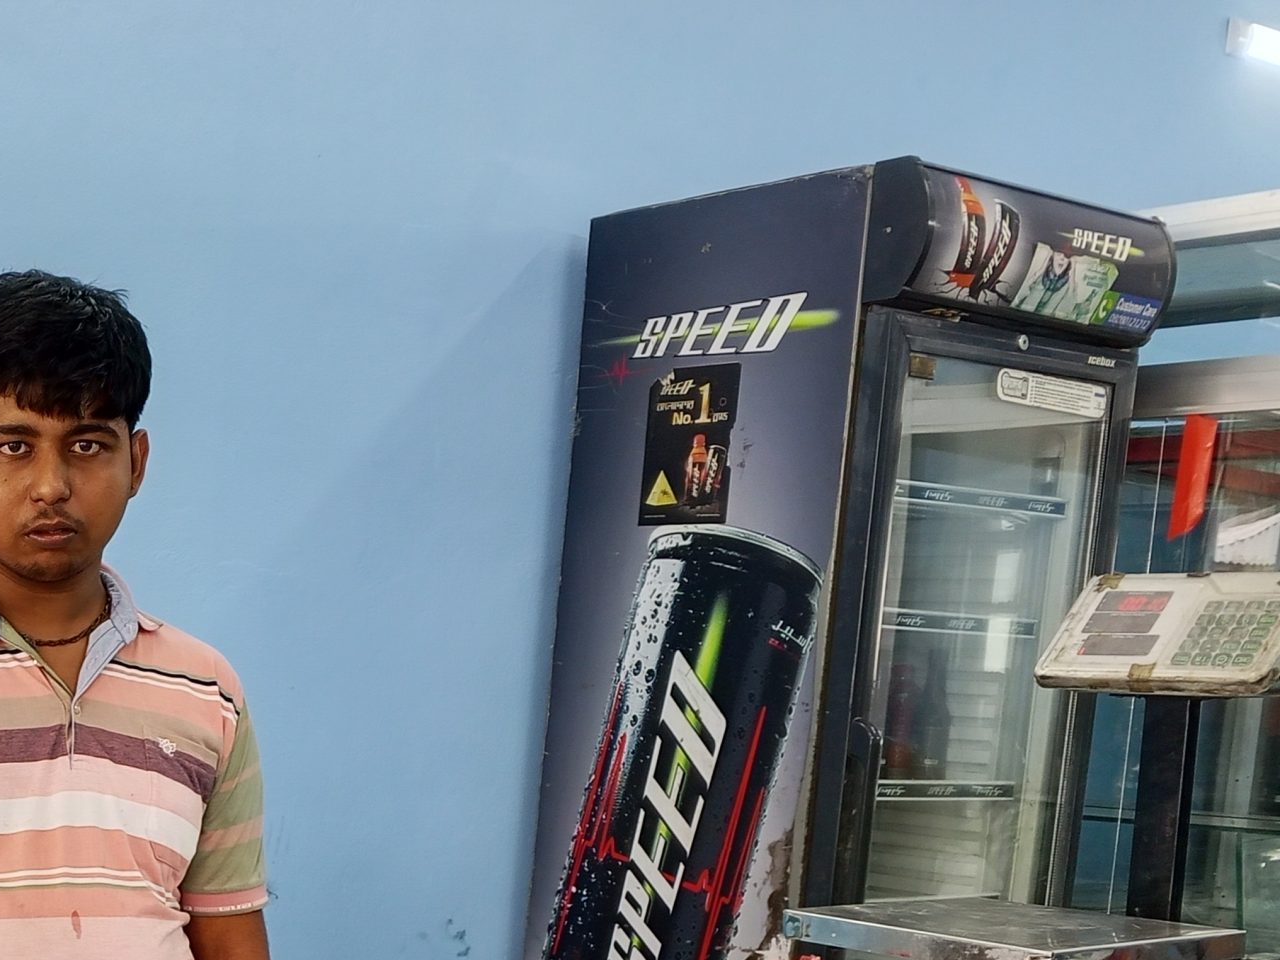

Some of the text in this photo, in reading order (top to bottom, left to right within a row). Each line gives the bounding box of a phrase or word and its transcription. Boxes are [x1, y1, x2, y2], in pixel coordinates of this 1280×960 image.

[983, 213, 1011, 283] SPEED
[1071, 228, 1133, 262] SPEED
[631, 291, 808, 359] SPEED
[1116, 297, 1158, 318] Customer Care
[694, 382, 711, 424] 1
